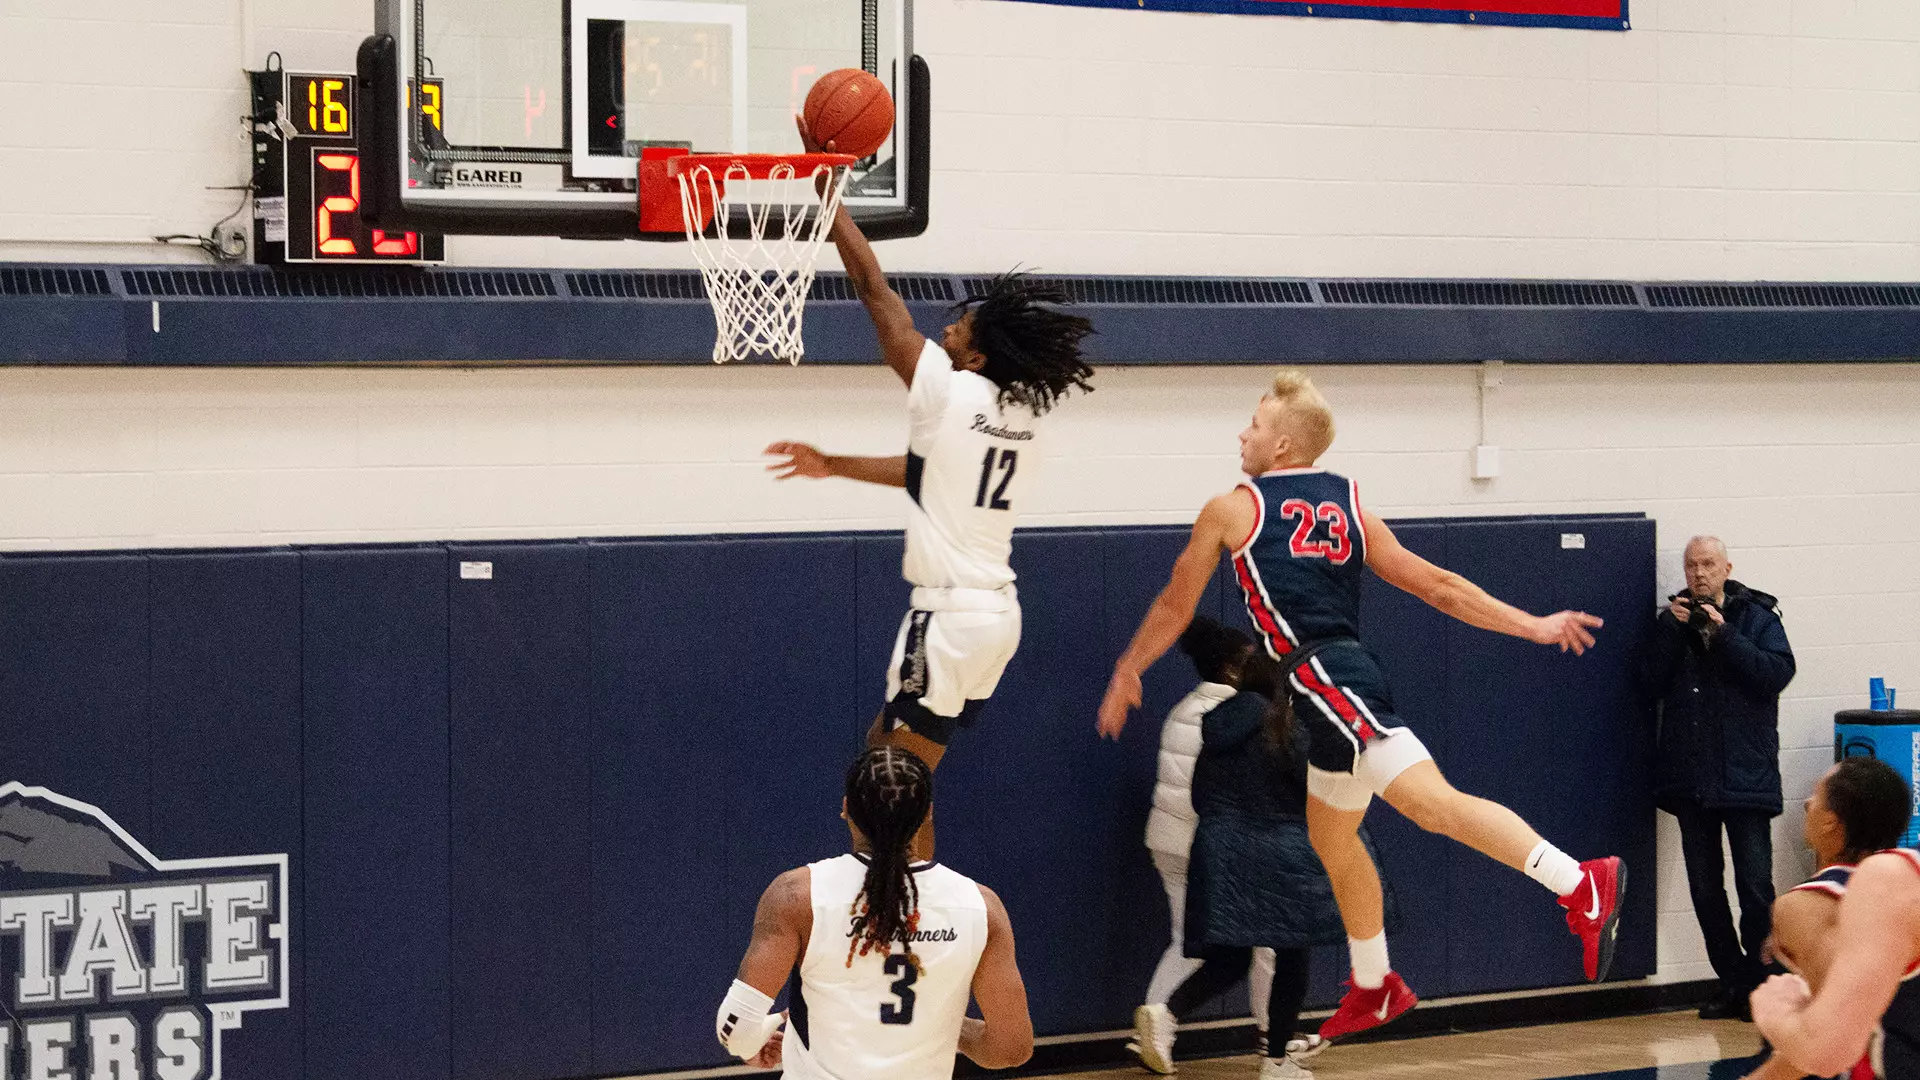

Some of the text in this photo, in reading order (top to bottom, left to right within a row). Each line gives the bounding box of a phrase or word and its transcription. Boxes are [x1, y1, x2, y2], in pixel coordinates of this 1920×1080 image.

[308, 80, 348, 132] 16
[456, 168, 522, 184] GARED
[974, 446, 1018, 510] 12
[1281, 498, 1352, 565] 23
[219, 1010, 236, 1021] TM
[880, 954, 918, 1025] 3
[0, 1010, 202, 1080] ERS
